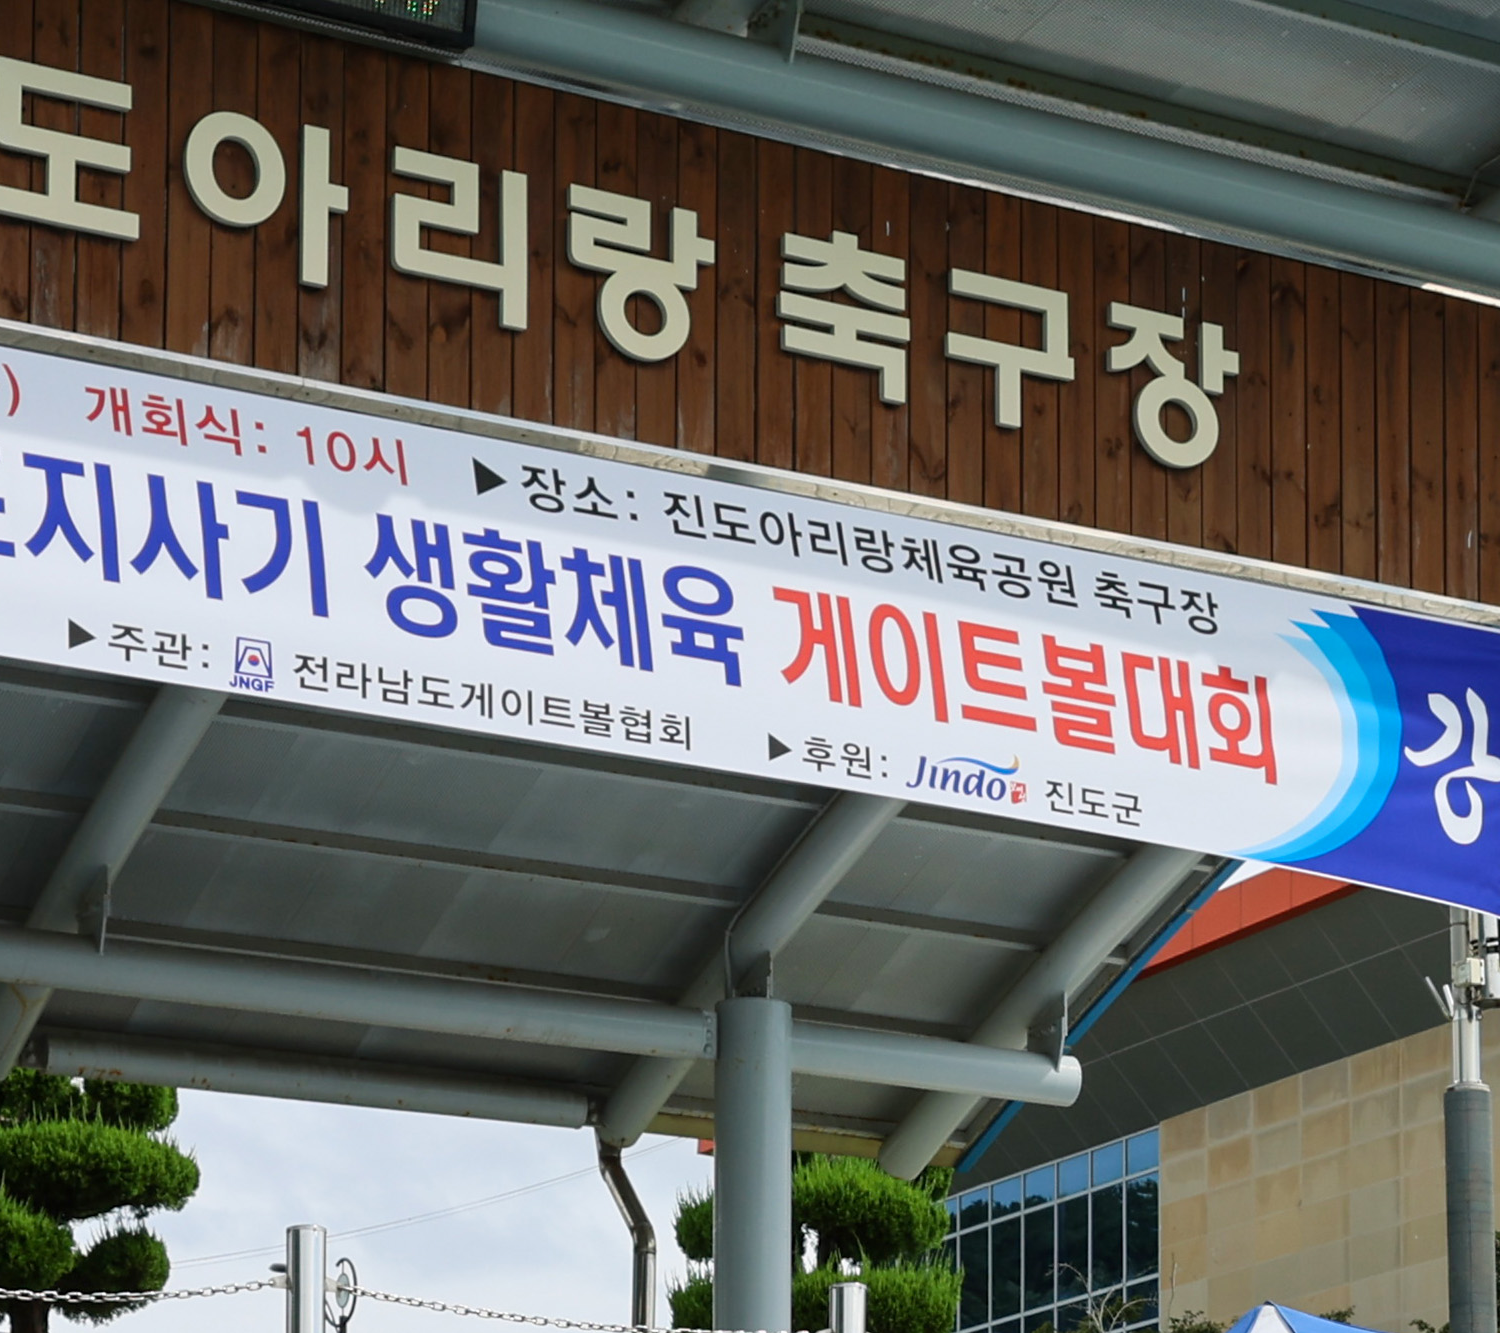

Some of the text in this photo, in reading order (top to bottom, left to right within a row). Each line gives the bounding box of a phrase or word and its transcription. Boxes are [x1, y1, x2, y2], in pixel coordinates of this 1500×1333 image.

[777, 230, 1241, 471] 축구장
[87, 388, 266, 454] 개회식:
[298, 428, 406, 483] 10시
[522, 465, 639, 522] 장소:
[663, 490, 1079, 608] 진도아리랑체육공원
[1094, 570, 1220, 636] 축구장
[109, 625, 208, 669] 주관:
[294, 655, 690, 750] 전라남도게이트볼협회
[803, 738, 886, 779] 후원:
[905, 755, 1007, 801] Jindo
[1045, 780, 1143, 827] 진도군
[229, 675, 275, 693] JNGF
[367, 515, 743, 685] 생활체육
[773, 587, 1277, 784] 게이트볼대회
